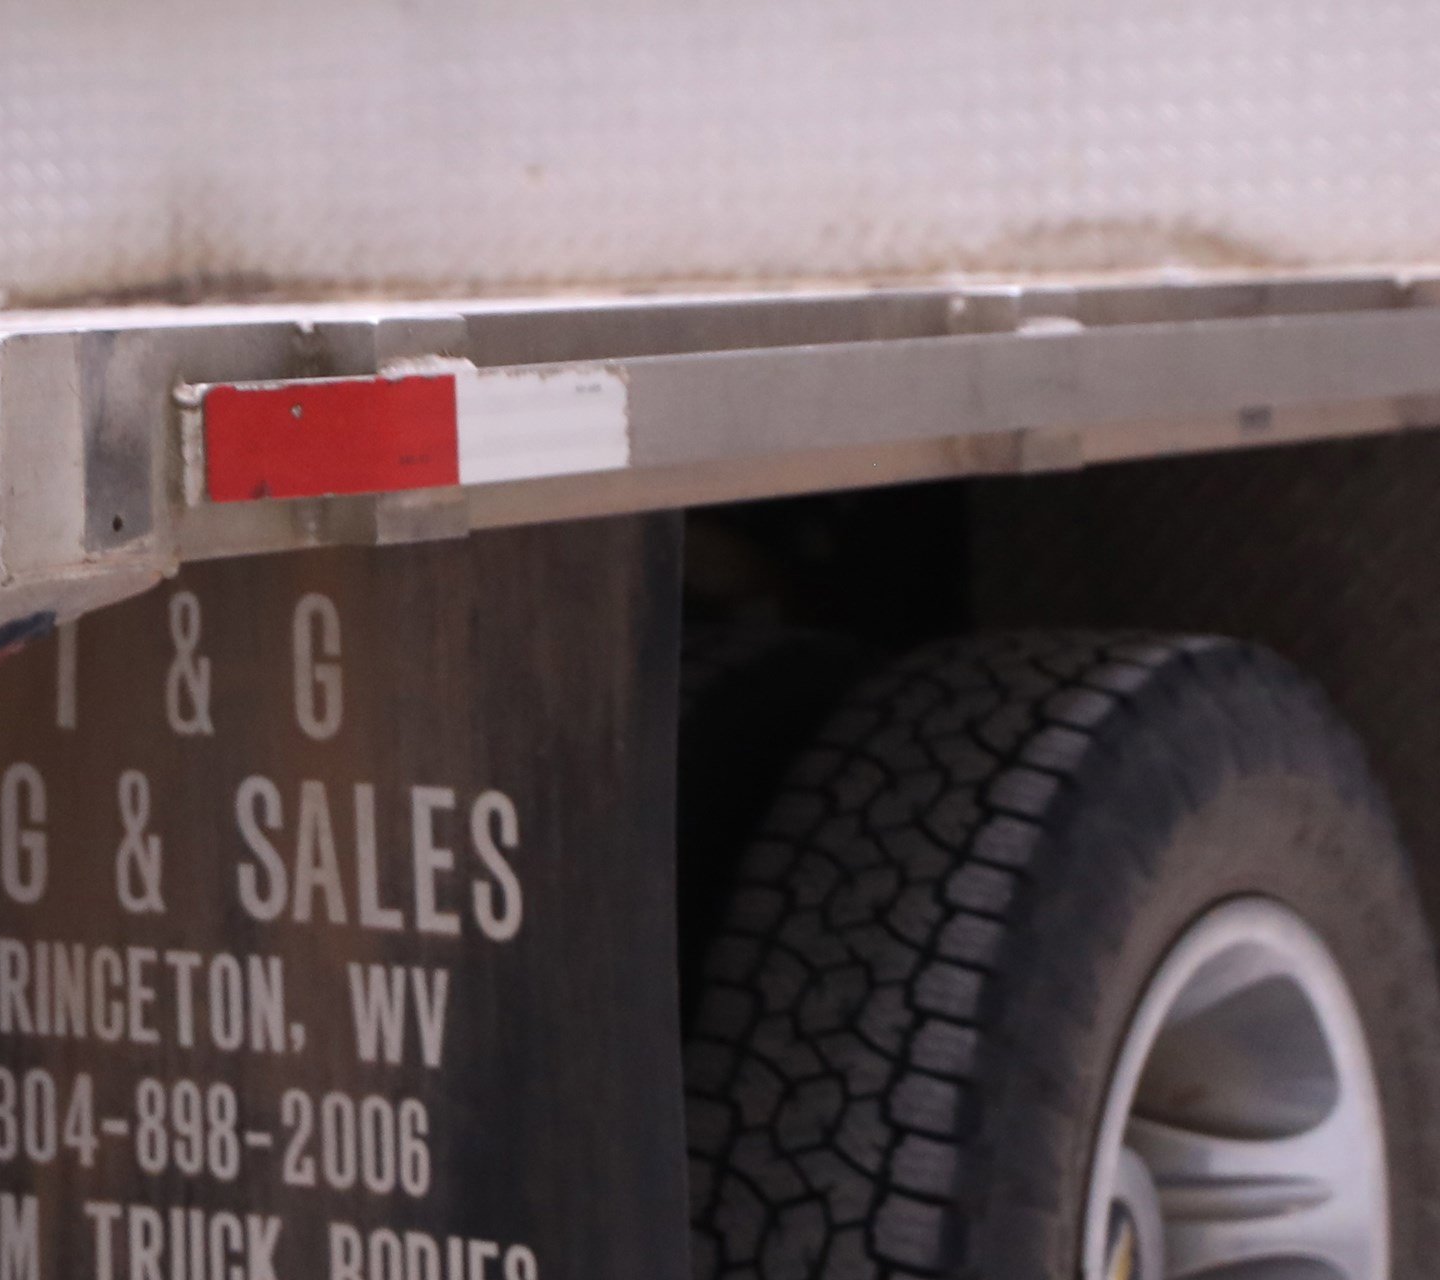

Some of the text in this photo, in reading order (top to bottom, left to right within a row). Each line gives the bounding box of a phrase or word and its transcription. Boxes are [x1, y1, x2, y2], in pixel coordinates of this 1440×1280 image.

[165, 590, 215, 737] &
[292, 592, 345, 740] G
[116, 769, 166, 914] &
[235, 774, 524, 943] SALES
[348, 962, 449, 1070] WV
